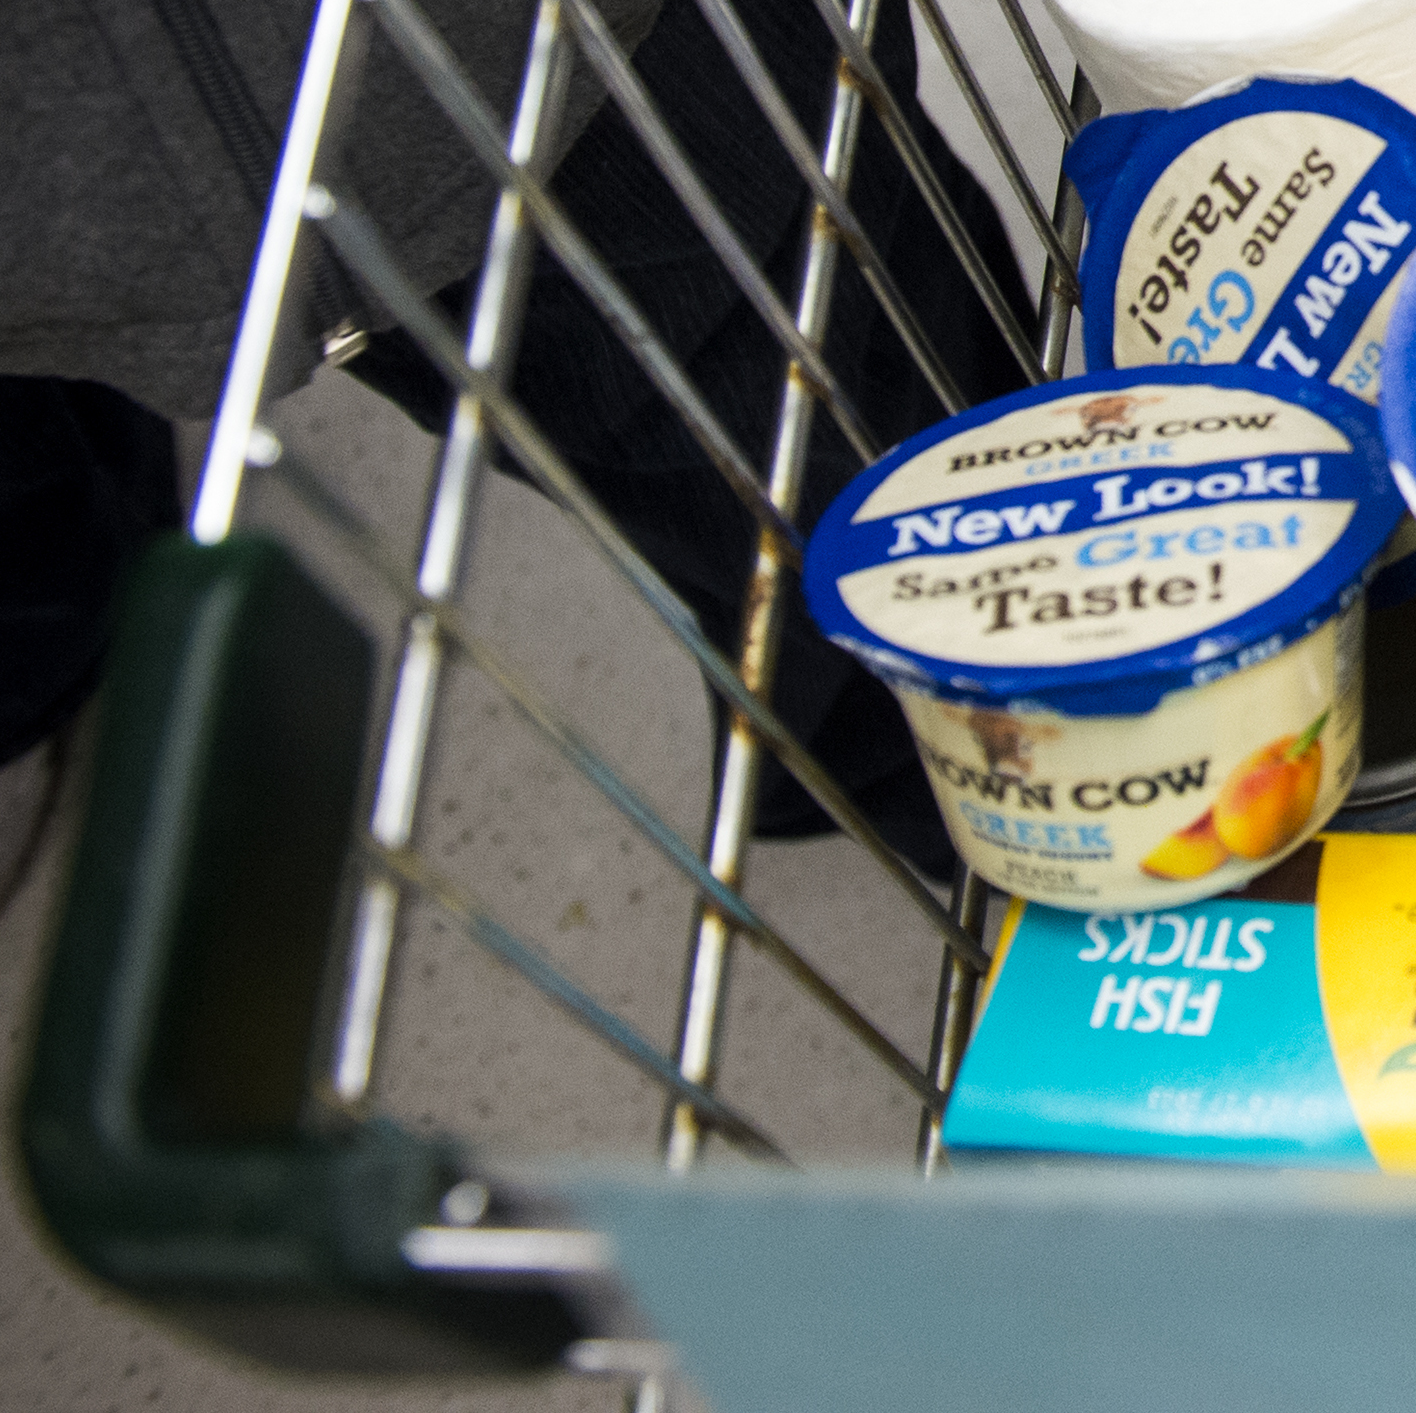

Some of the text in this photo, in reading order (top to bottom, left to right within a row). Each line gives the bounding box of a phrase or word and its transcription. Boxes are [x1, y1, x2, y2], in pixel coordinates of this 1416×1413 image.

[1241, 147, 1336, 267] Same
[1128, 161, 1260, 345] Taste!
[1295, 191, 1411, 338] New
[1168, 270, 1255, 365] Gre
[946, 412, 1279, 474] BROWN COW
[1025, 441, 1175, 478] GREEK
[888, 458, 1321, 557] New Look!
[891, 514, 1306, 602] Same Great
[972, 562, 1226, 636] Taste!
[1071, 759, 1212, 813] COW
[959, 800, 1114, 851] GREEK
[1076, 913, 1276, 974] STICKS
[1090, 975, 1224, 1037] FISH
